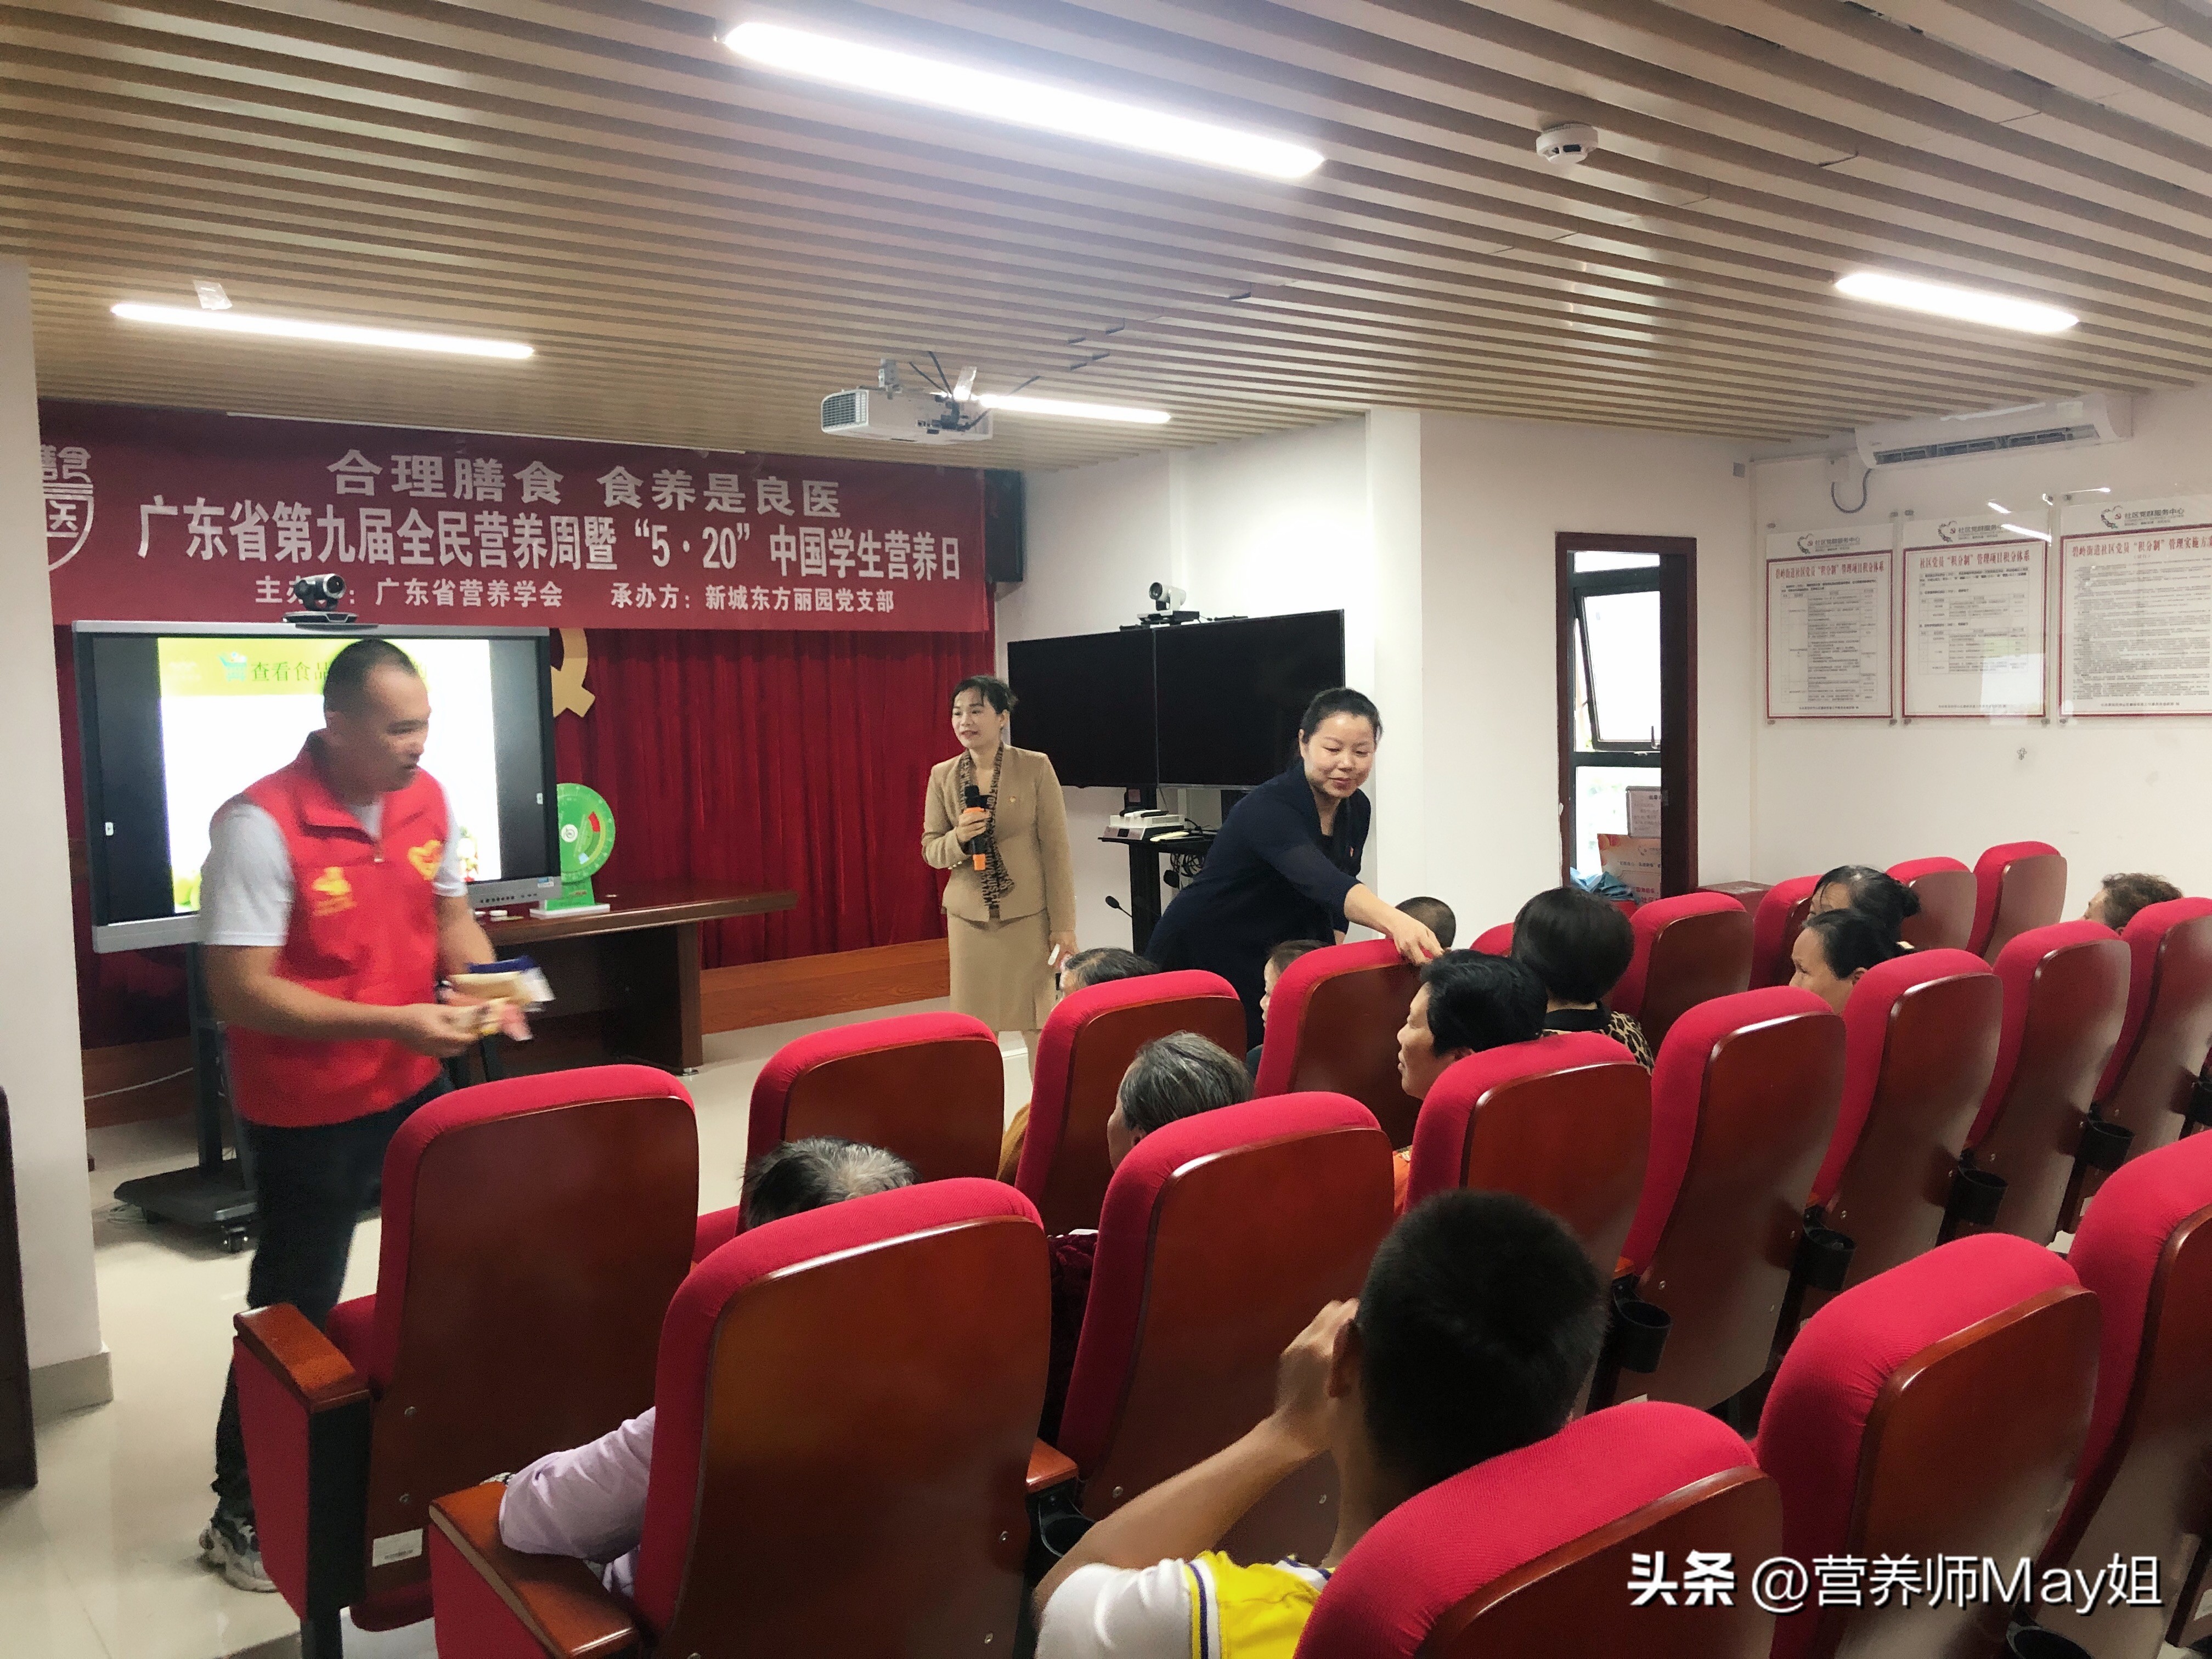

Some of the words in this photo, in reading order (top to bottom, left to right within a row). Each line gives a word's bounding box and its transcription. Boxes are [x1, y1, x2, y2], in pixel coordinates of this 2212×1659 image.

[326, 449, 564, 504] 合理膳食
[596, 465, 841, 518] 食养是良医
[2124, 508, 2185, 519] 社区党群服务中心
[256, 575, 562, 607] 主：广东省营养学会
[611, 582, 894, 613] 承办方：新城东方丽园党支部
